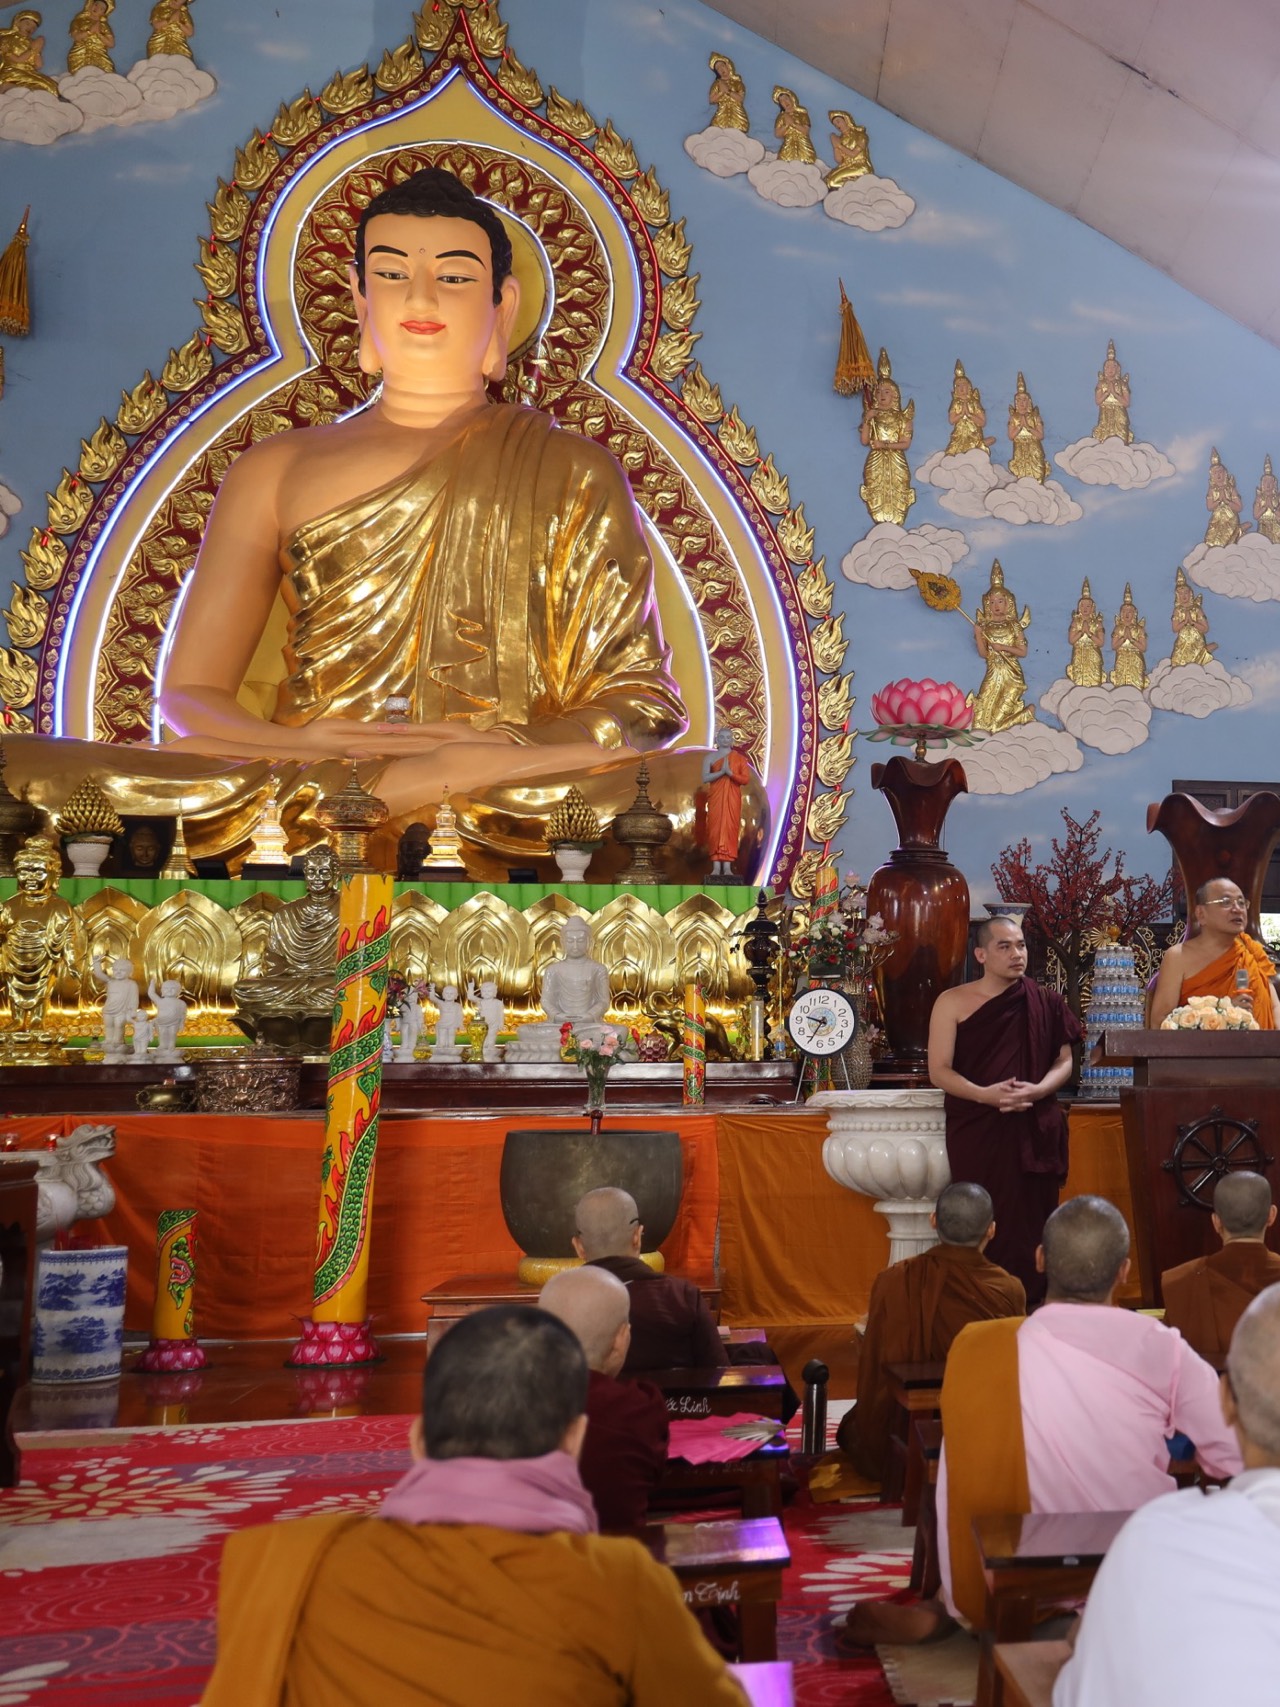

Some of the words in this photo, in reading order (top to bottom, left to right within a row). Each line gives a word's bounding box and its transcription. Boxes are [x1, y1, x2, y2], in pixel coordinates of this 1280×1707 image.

[809, 998, 816, 1006] 11
[819, 995, 829, 1004] 12
[800, 1005, 810, 1014] 10
[838, 1008, 847, 1018] 2
[795, 1016, 803, 1024] 9
[841, 1019, 849, 1028] 3
[797, 1027, 805, 1036] 8
[836, 1029, 844, 1039] 4
[816, 1040, 824, 1048] 6
[828, 1038, 836, 1046] 5
